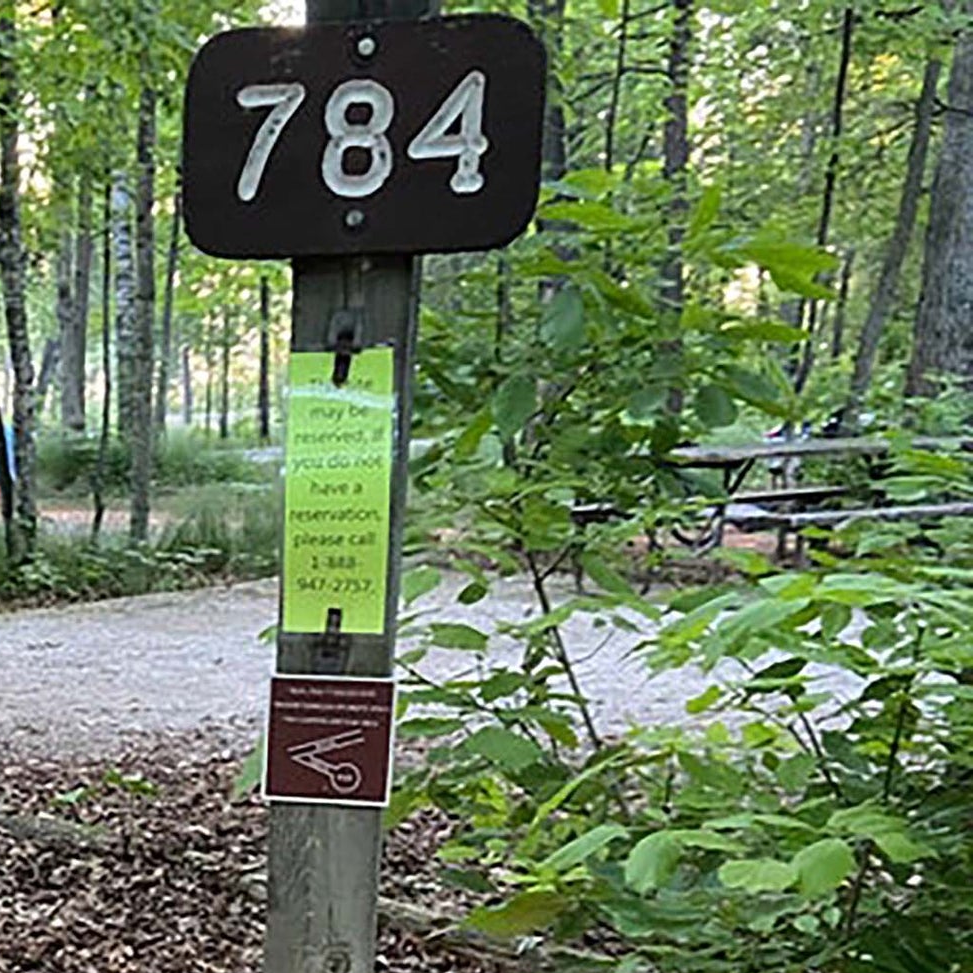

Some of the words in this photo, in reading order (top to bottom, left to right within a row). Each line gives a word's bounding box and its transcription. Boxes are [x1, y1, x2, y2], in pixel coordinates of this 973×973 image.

[236, 69, 489, 201] 784
[291, 457, 323, 473] you
[328, 455, 350, 469] do
[354, 456, 382, 469] not
[310, 482, 348, 495] have
[353, 483, 362, 494] a
[294, 533, 343, 548] please
[348, 532, 375, 545] call
